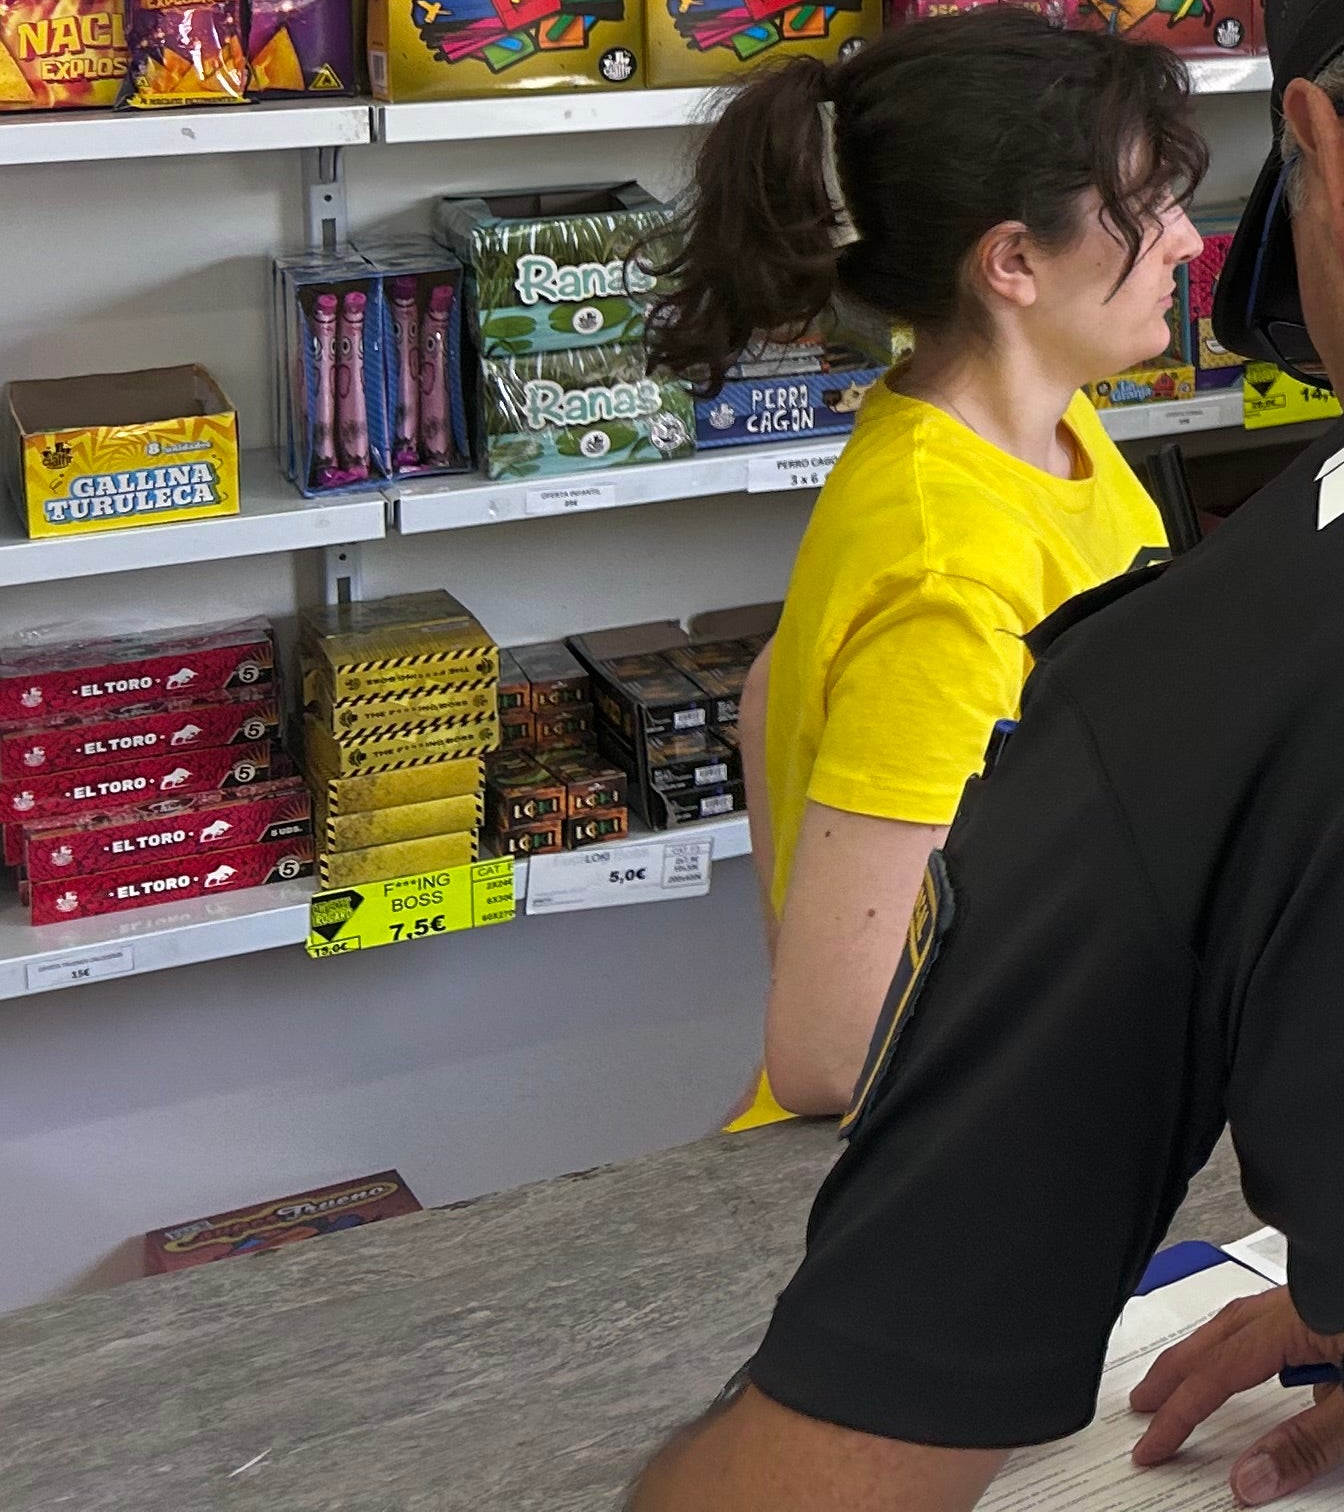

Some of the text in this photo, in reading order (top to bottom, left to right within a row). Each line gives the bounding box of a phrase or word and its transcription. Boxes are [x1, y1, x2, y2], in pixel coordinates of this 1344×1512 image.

[515, 255, 658, 305] Ranas
[524, 380, 662, 429] Ranas
[752, 385, 808, 410] PERRO
[147, 442, 161, 456] 8
[73, 463, 214, 498] GALLINA
[47, 483, 215, 522] TURULECA
[81, 677, 153, 697] EL TORO
[85, 734, 157, 755] EL TORO
[74, 778, 147, 799] EL TORO
[112, 830, 186, 854] EL TORO
[478, 864, 501, 877] CAT
[609, 868, 647, 884] 5,0€
[117, 876, 191, 899] EL TORO
[391, 891, 444, 913] BOSS
[388, 914, 447, 941] 7,5€
